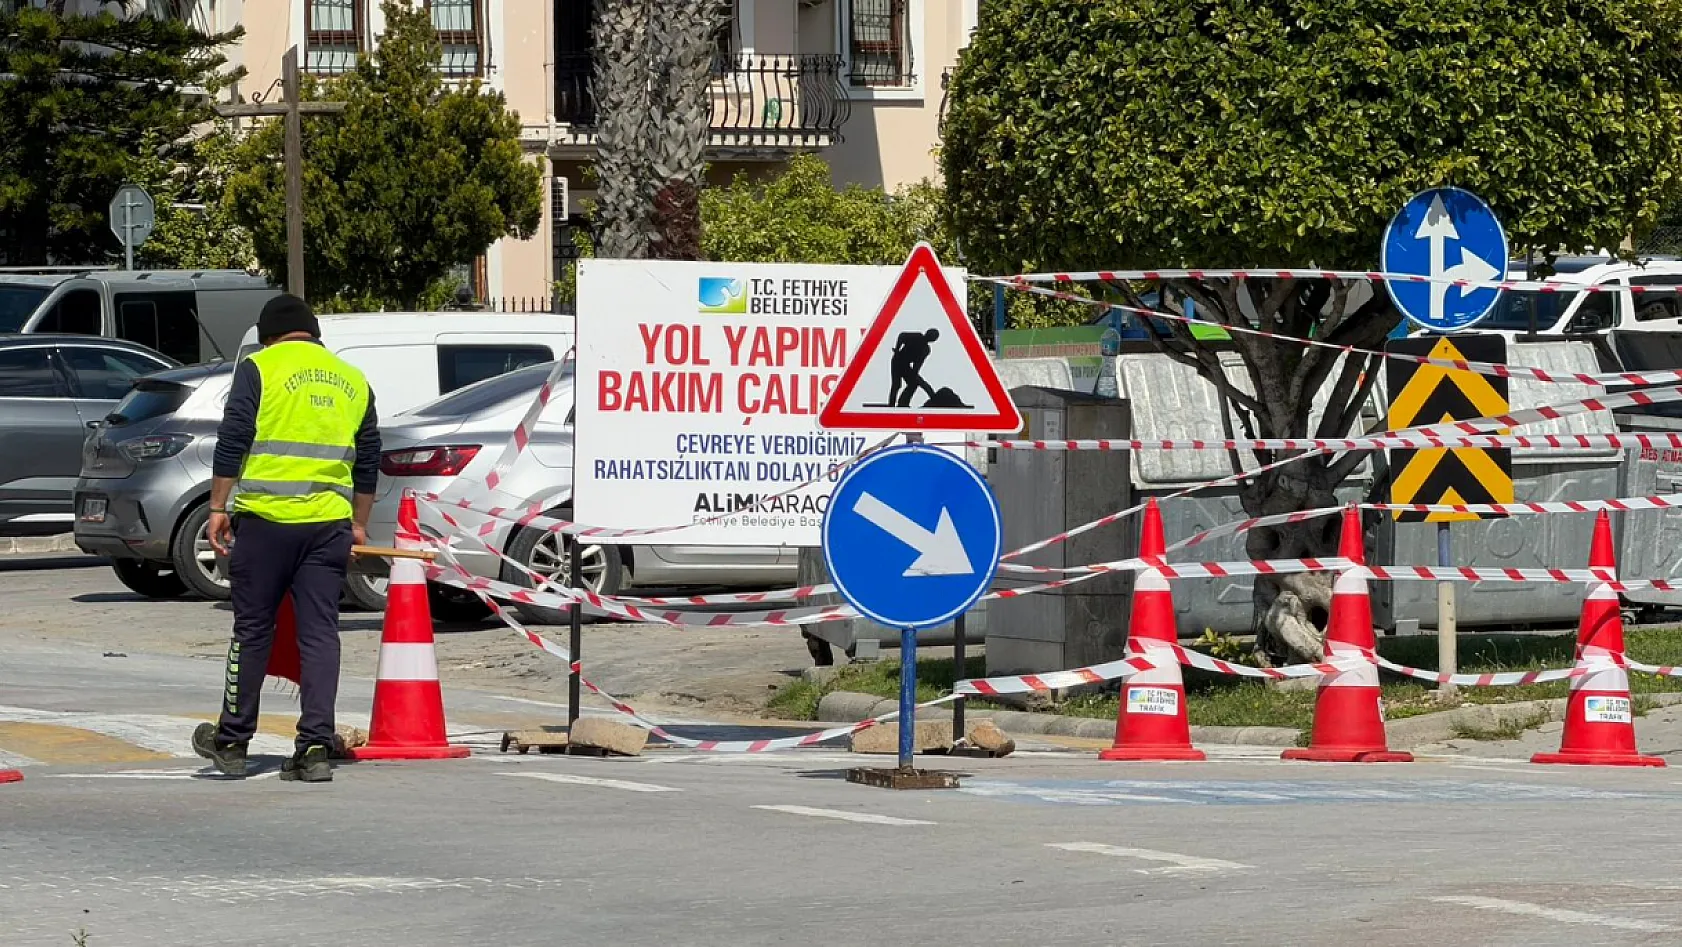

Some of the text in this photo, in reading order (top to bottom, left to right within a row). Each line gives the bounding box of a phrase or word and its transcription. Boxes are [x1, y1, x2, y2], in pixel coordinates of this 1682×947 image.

[750, 278, 777, 295] T.C.
[638, 323, 847, 367] YOL YAPIM
[598, 370, 723, 413] BAKIM
[676, 433, 755, 459] ÇEVREYE
[594, 458, 750, 481] RAHATSIZLIKTAN
[756, 462, 821, 483] DOLAYI
[692, 514, 737, 527] Fethiye
[742, 515, 795, 529] Belediye
